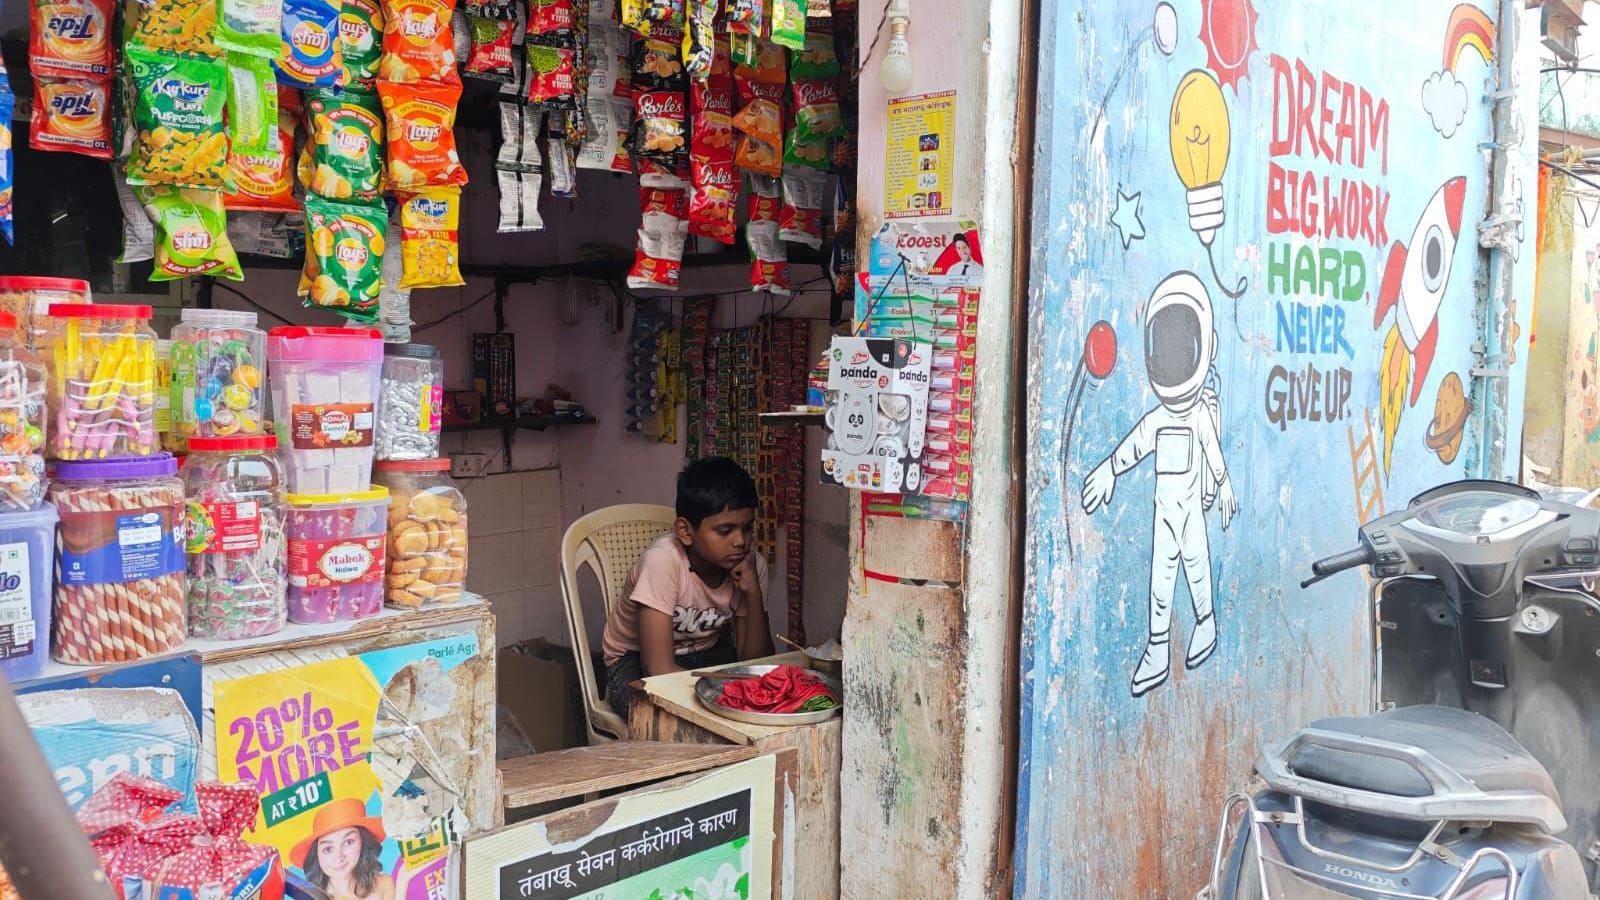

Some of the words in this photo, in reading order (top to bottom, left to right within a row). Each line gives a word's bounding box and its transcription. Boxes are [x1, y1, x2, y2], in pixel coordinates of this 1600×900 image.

[48, 15, 94, 38] Tide
[650, 24, 681, 37] arle's
[155, 79, 210, 99] Kurkure
[51, 93, 96, 116] Tide
[638, 93, 682, 115] Parle's
[1269, 52, 1390, 177] DREAM
[1322, 172, 1391, 250] WORK
[1275, 300, 1356, 361] NEVER
[840, 366, 878, 379] panda
[899, 370, 928, 383] panda
[1265, 362, 1322, 432] GIVE
[0, 572, 21, 592] lo
[457, 643, 476, 656] Agr
[229, 691, 334, 765] 20%
[236, 719, 367, 794] MORE
[271, 803, 286, 822] AT
[518, 866, 577, 898] तंबाखू
[577, 848, 617, 878] सेवन
[620, 816, 695, 862] कर्करोगाचे
[699, 807, 738, 836] कारण
[424, 868, 446, 892] EX
[1324, 864, 1398, 889] HONDA
